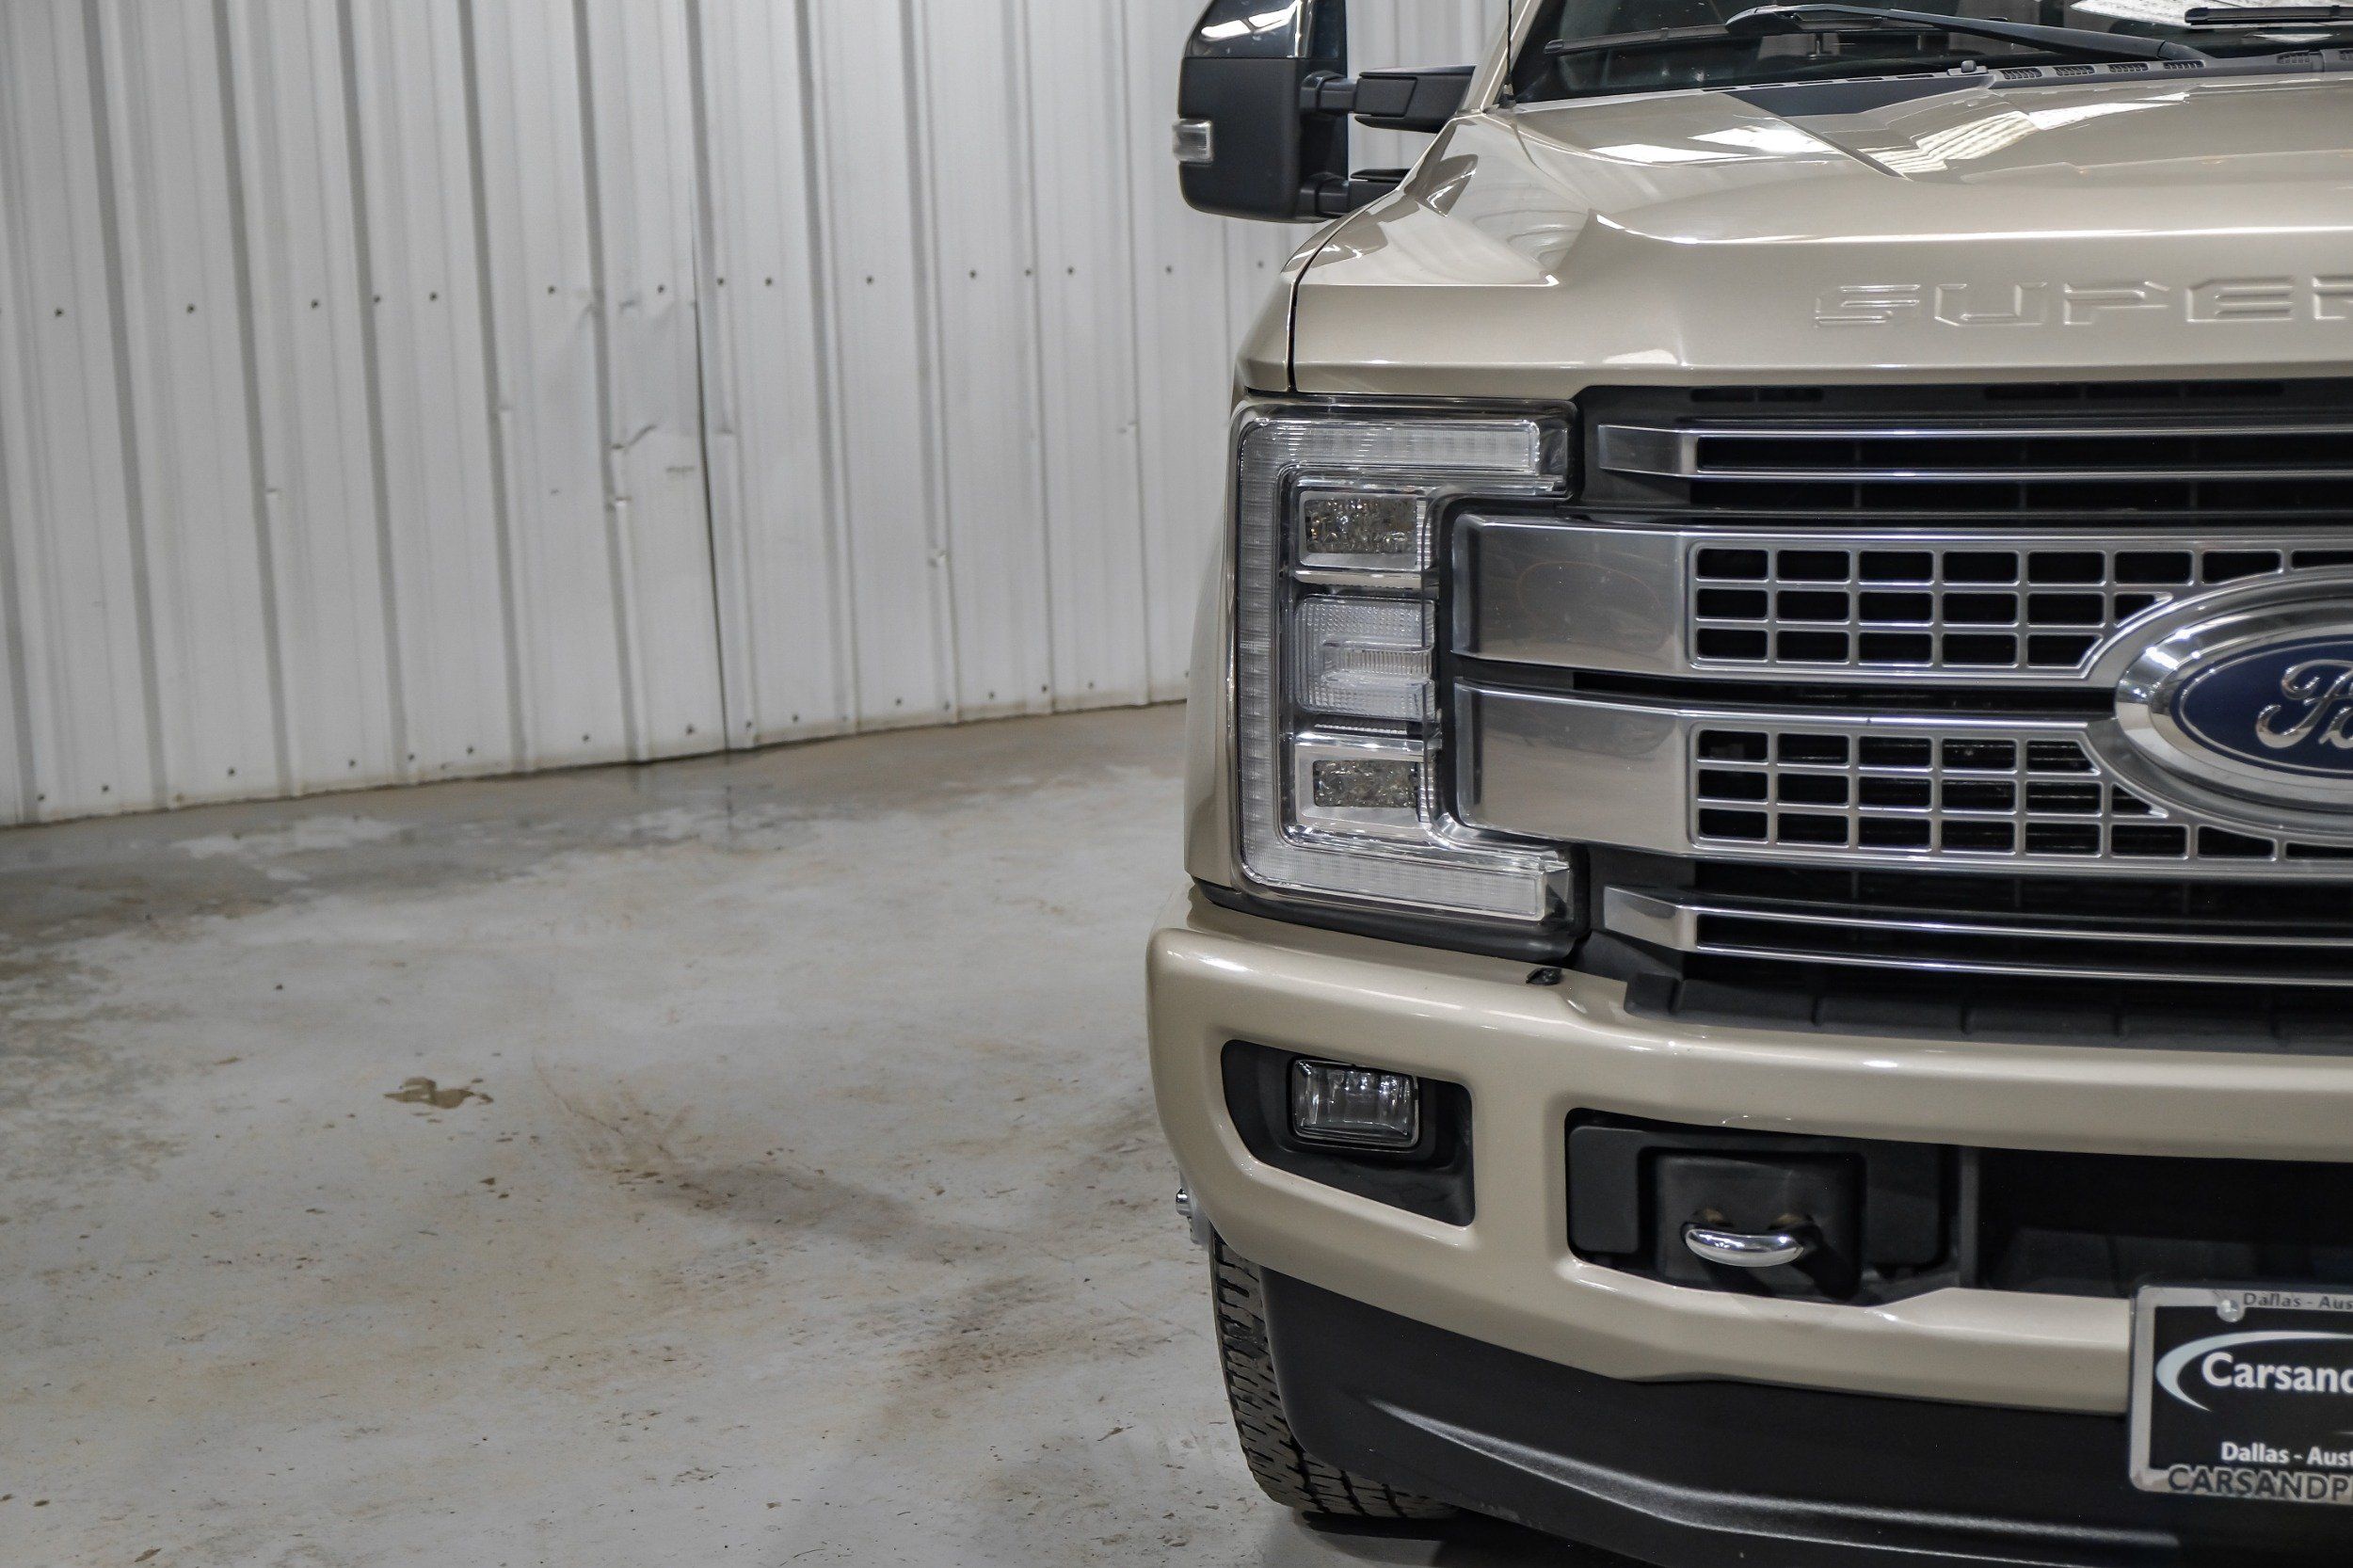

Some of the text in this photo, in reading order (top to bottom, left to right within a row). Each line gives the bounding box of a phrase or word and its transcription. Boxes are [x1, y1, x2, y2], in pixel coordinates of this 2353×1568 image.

[2244, 1292, 2301, 1307] Dallas
[2221, 1441, 2290, 1464] Dallas
[2168, 1464, 2353, 1501] CARSANDP
